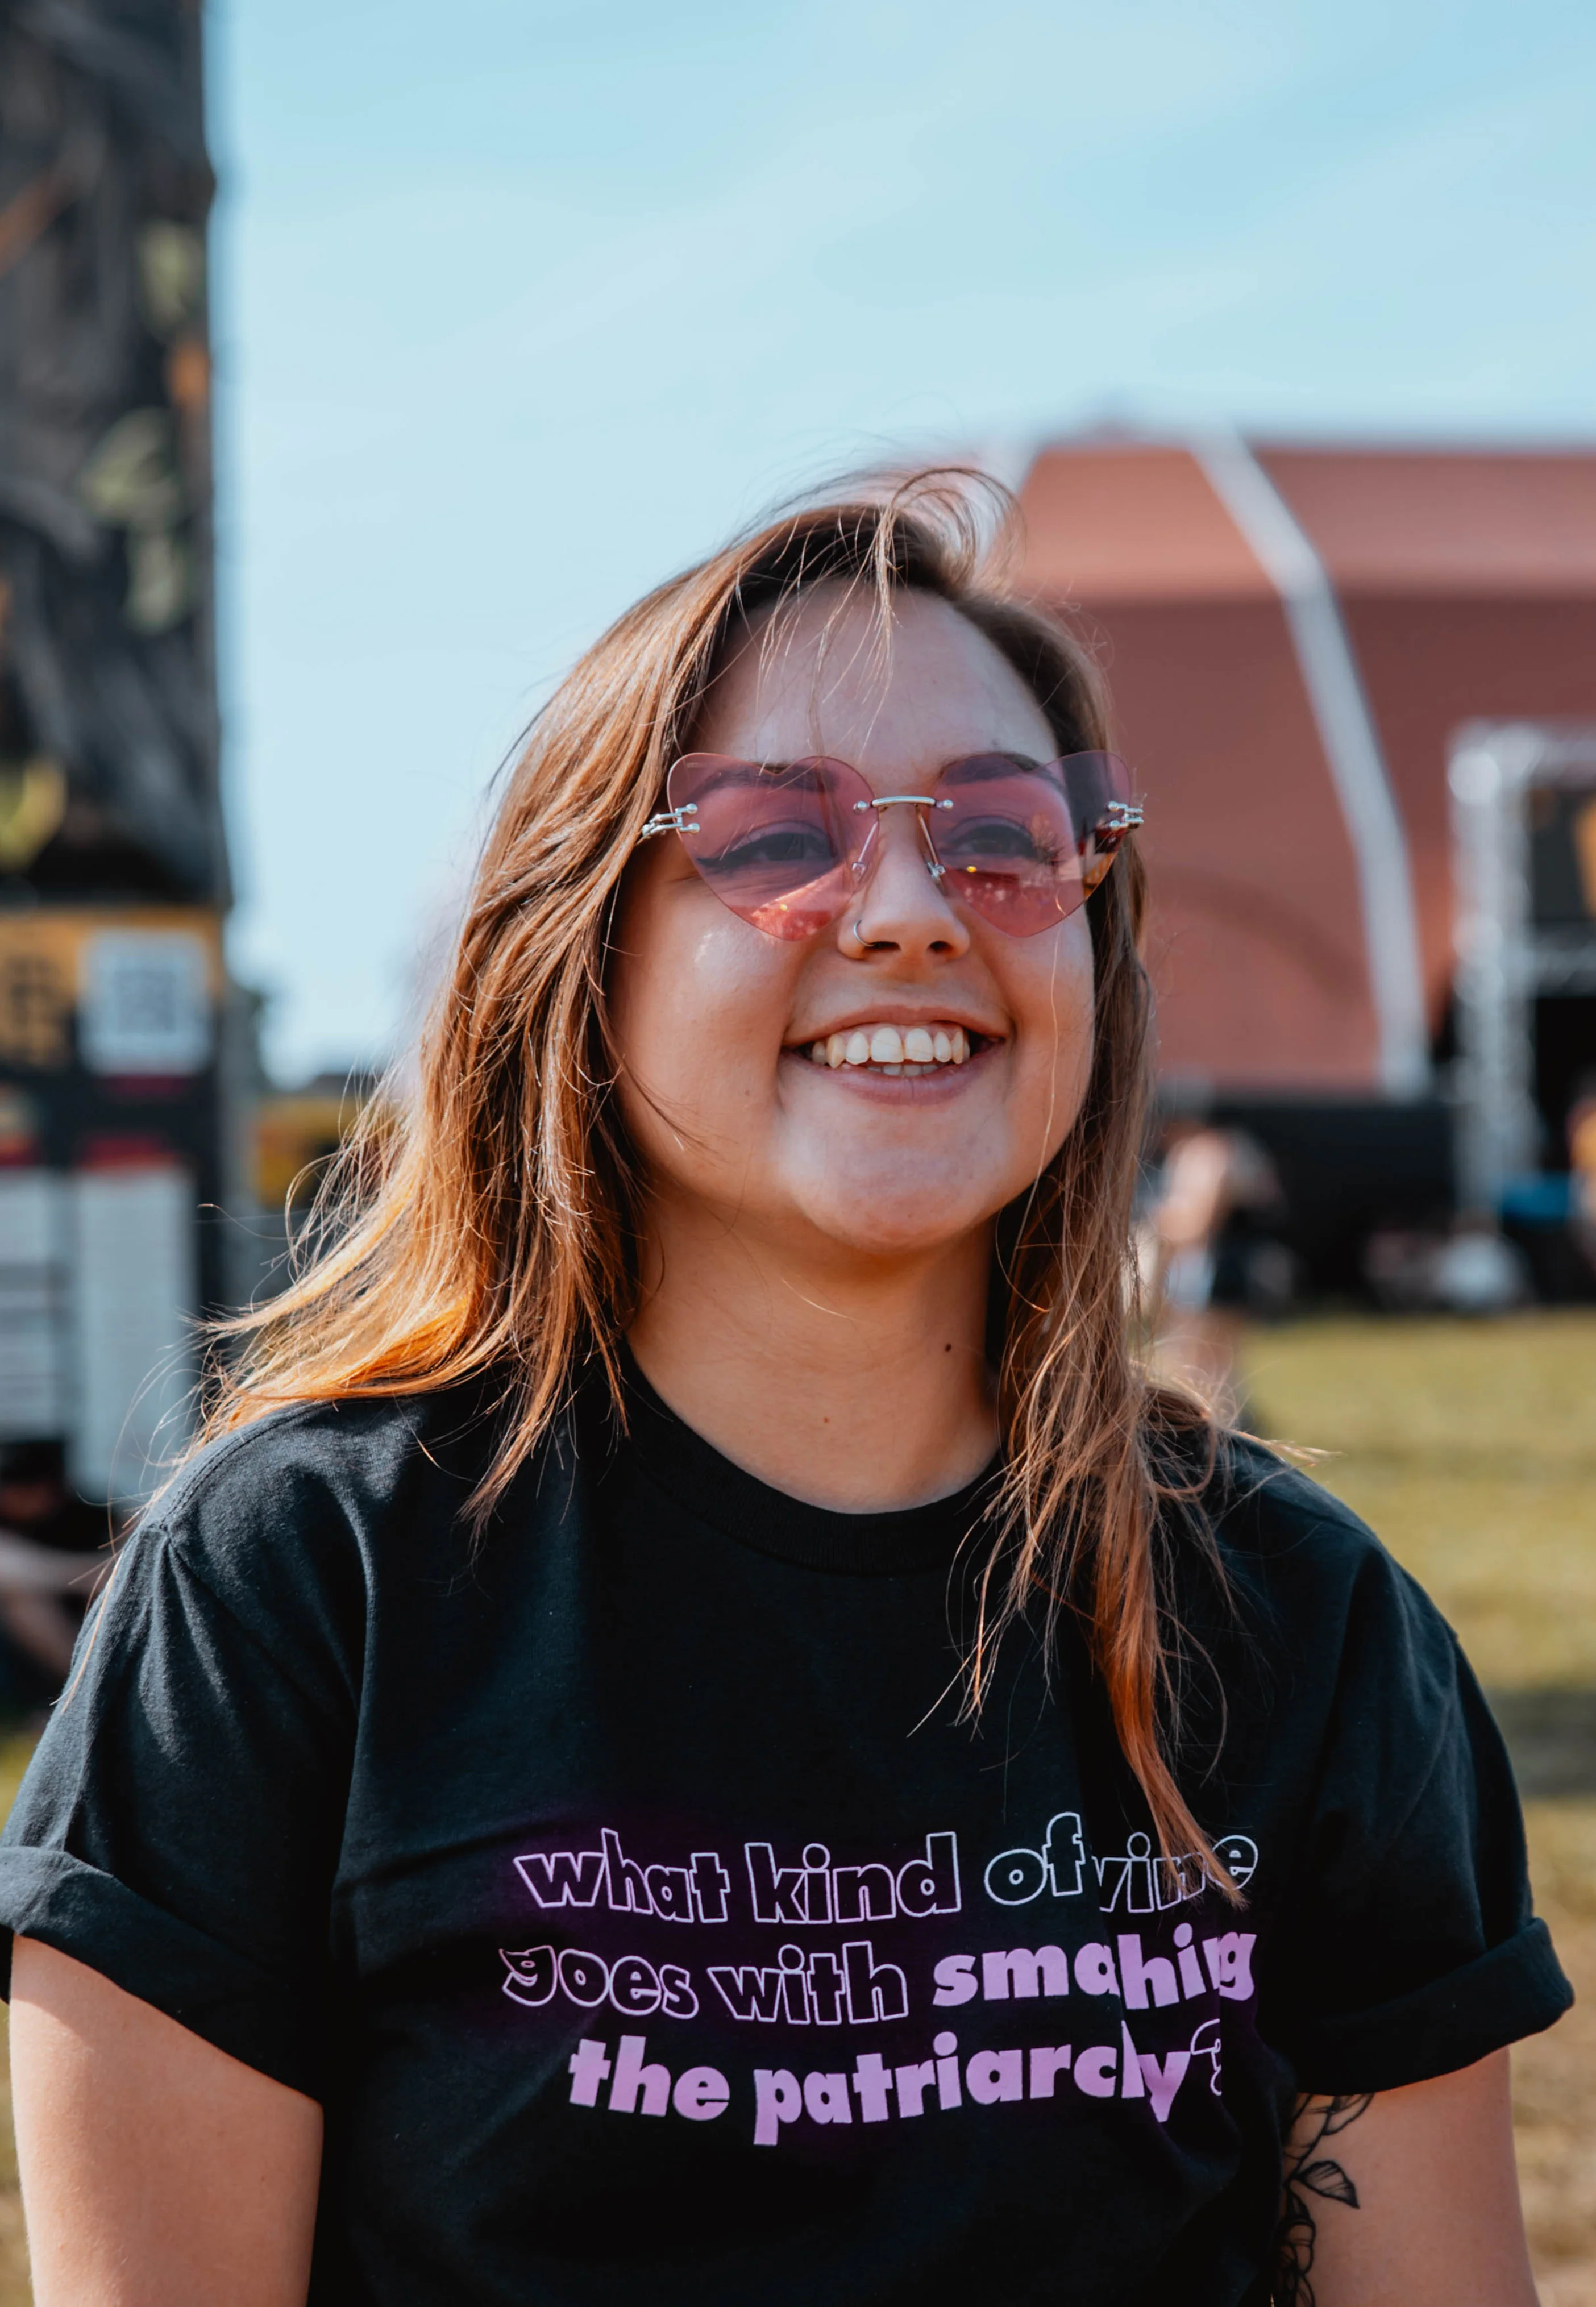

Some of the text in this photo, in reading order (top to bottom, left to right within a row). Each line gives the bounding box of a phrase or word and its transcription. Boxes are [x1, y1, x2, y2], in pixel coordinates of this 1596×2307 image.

[513, 1828, 730, 1923] what
[744, 1831, 962, 1924] kind
[984, 1811, 1086, 1906] of
[498, 1945, 699, 2019] goes
[706, 1940, 909, 2025] with
[569, 2035, 730, 2121] the
